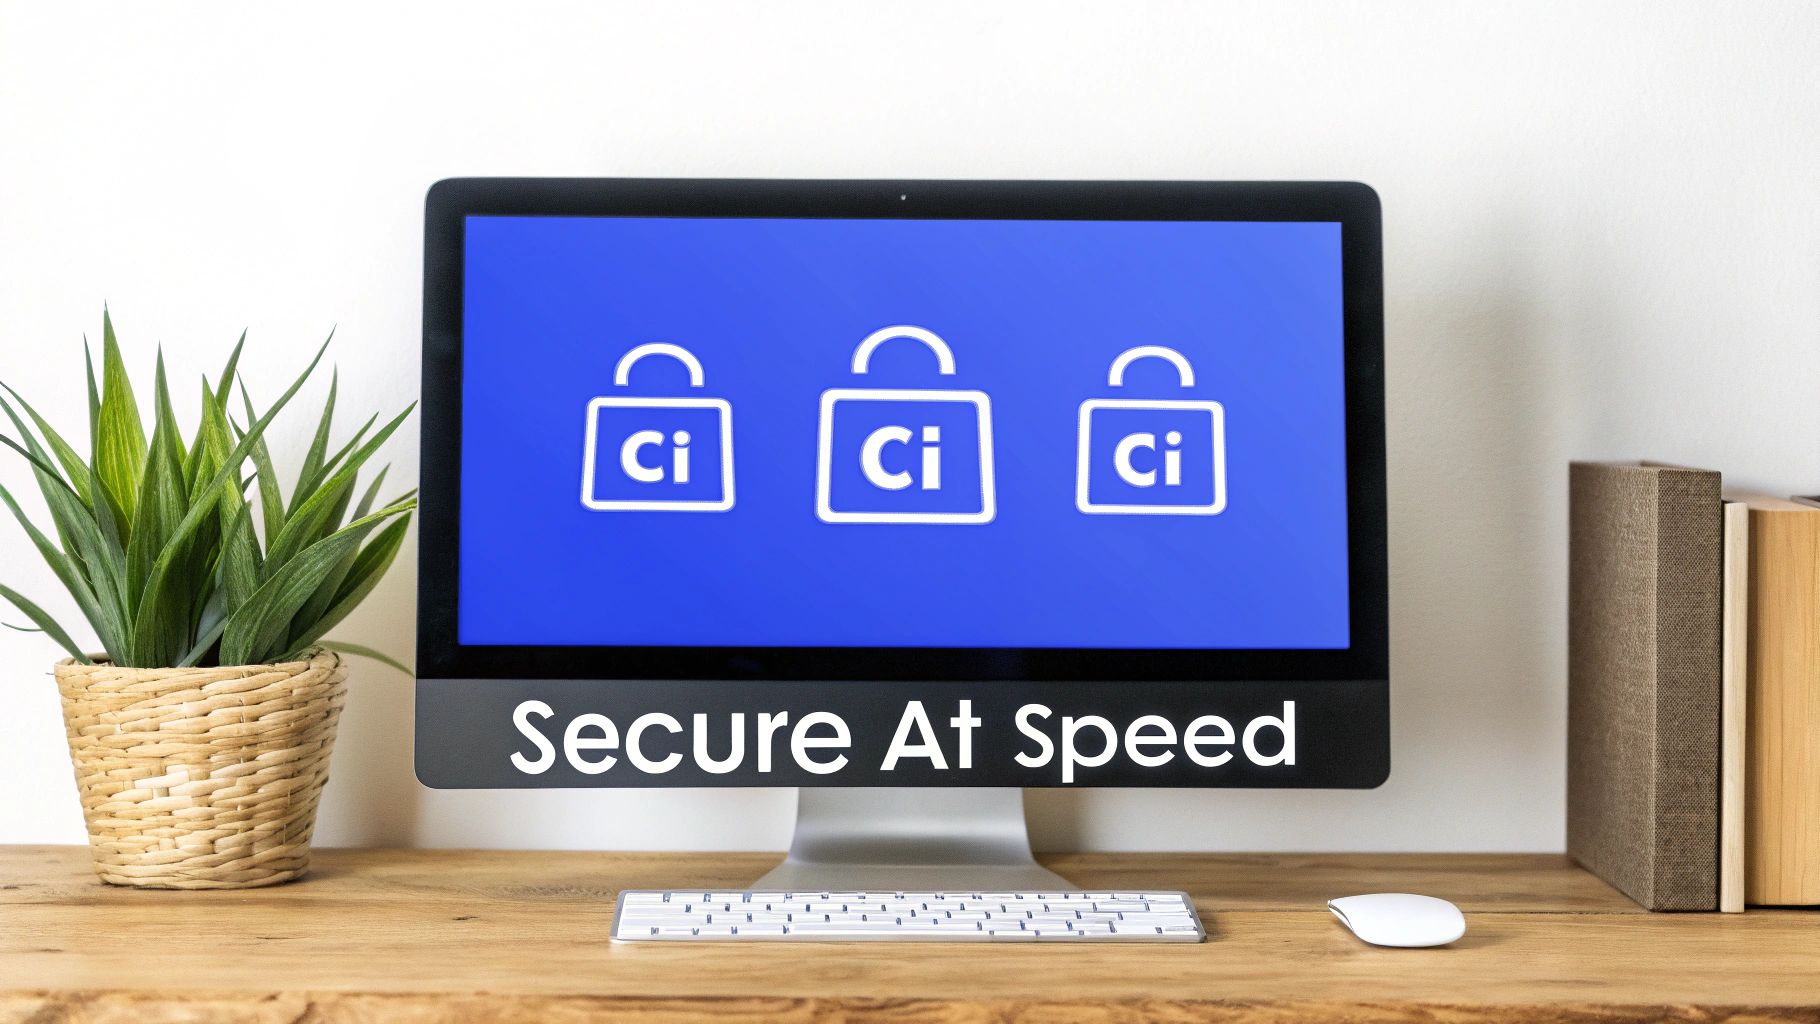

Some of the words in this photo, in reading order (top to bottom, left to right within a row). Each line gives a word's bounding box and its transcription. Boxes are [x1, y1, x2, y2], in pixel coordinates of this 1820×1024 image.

[621, 430, 690, 483] Ci
[861, 425, 941, 490] Ci
[1114, 431, 1182, 487] Ci
[510, 700, 852, 775] Secure
[880, 700, 982, 771] At
[1014, 701, 1296, 784] Speed
